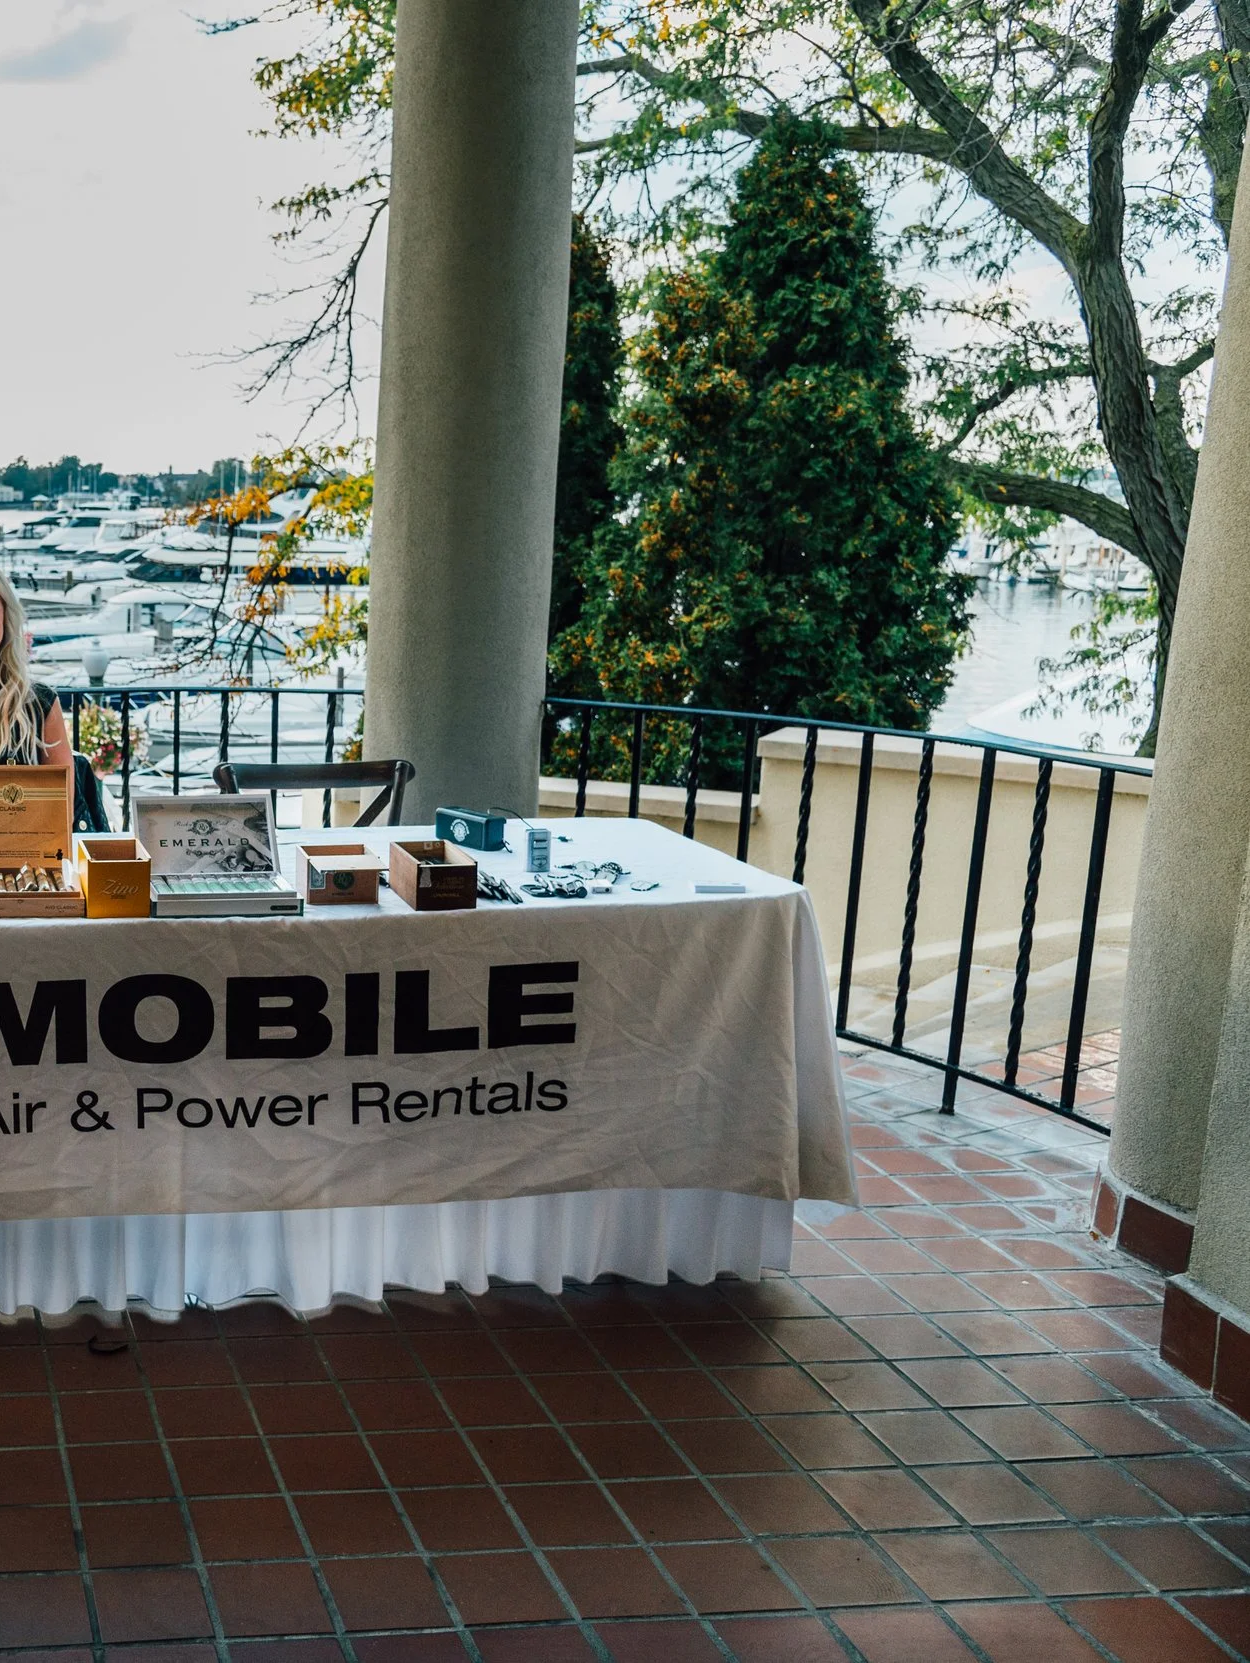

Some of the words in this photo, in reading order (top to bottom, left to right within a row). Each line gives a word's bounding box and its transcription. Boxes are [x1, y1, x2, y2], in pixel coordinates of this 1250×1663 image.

[159, 837, 250, 848] EMERALD
[102, 878, 140, 896] Zino
[69, 1089, 116, 1133] &
[136, 1086, 329, 1129] Power
[350, 1070, 570, 1125] Rentals
